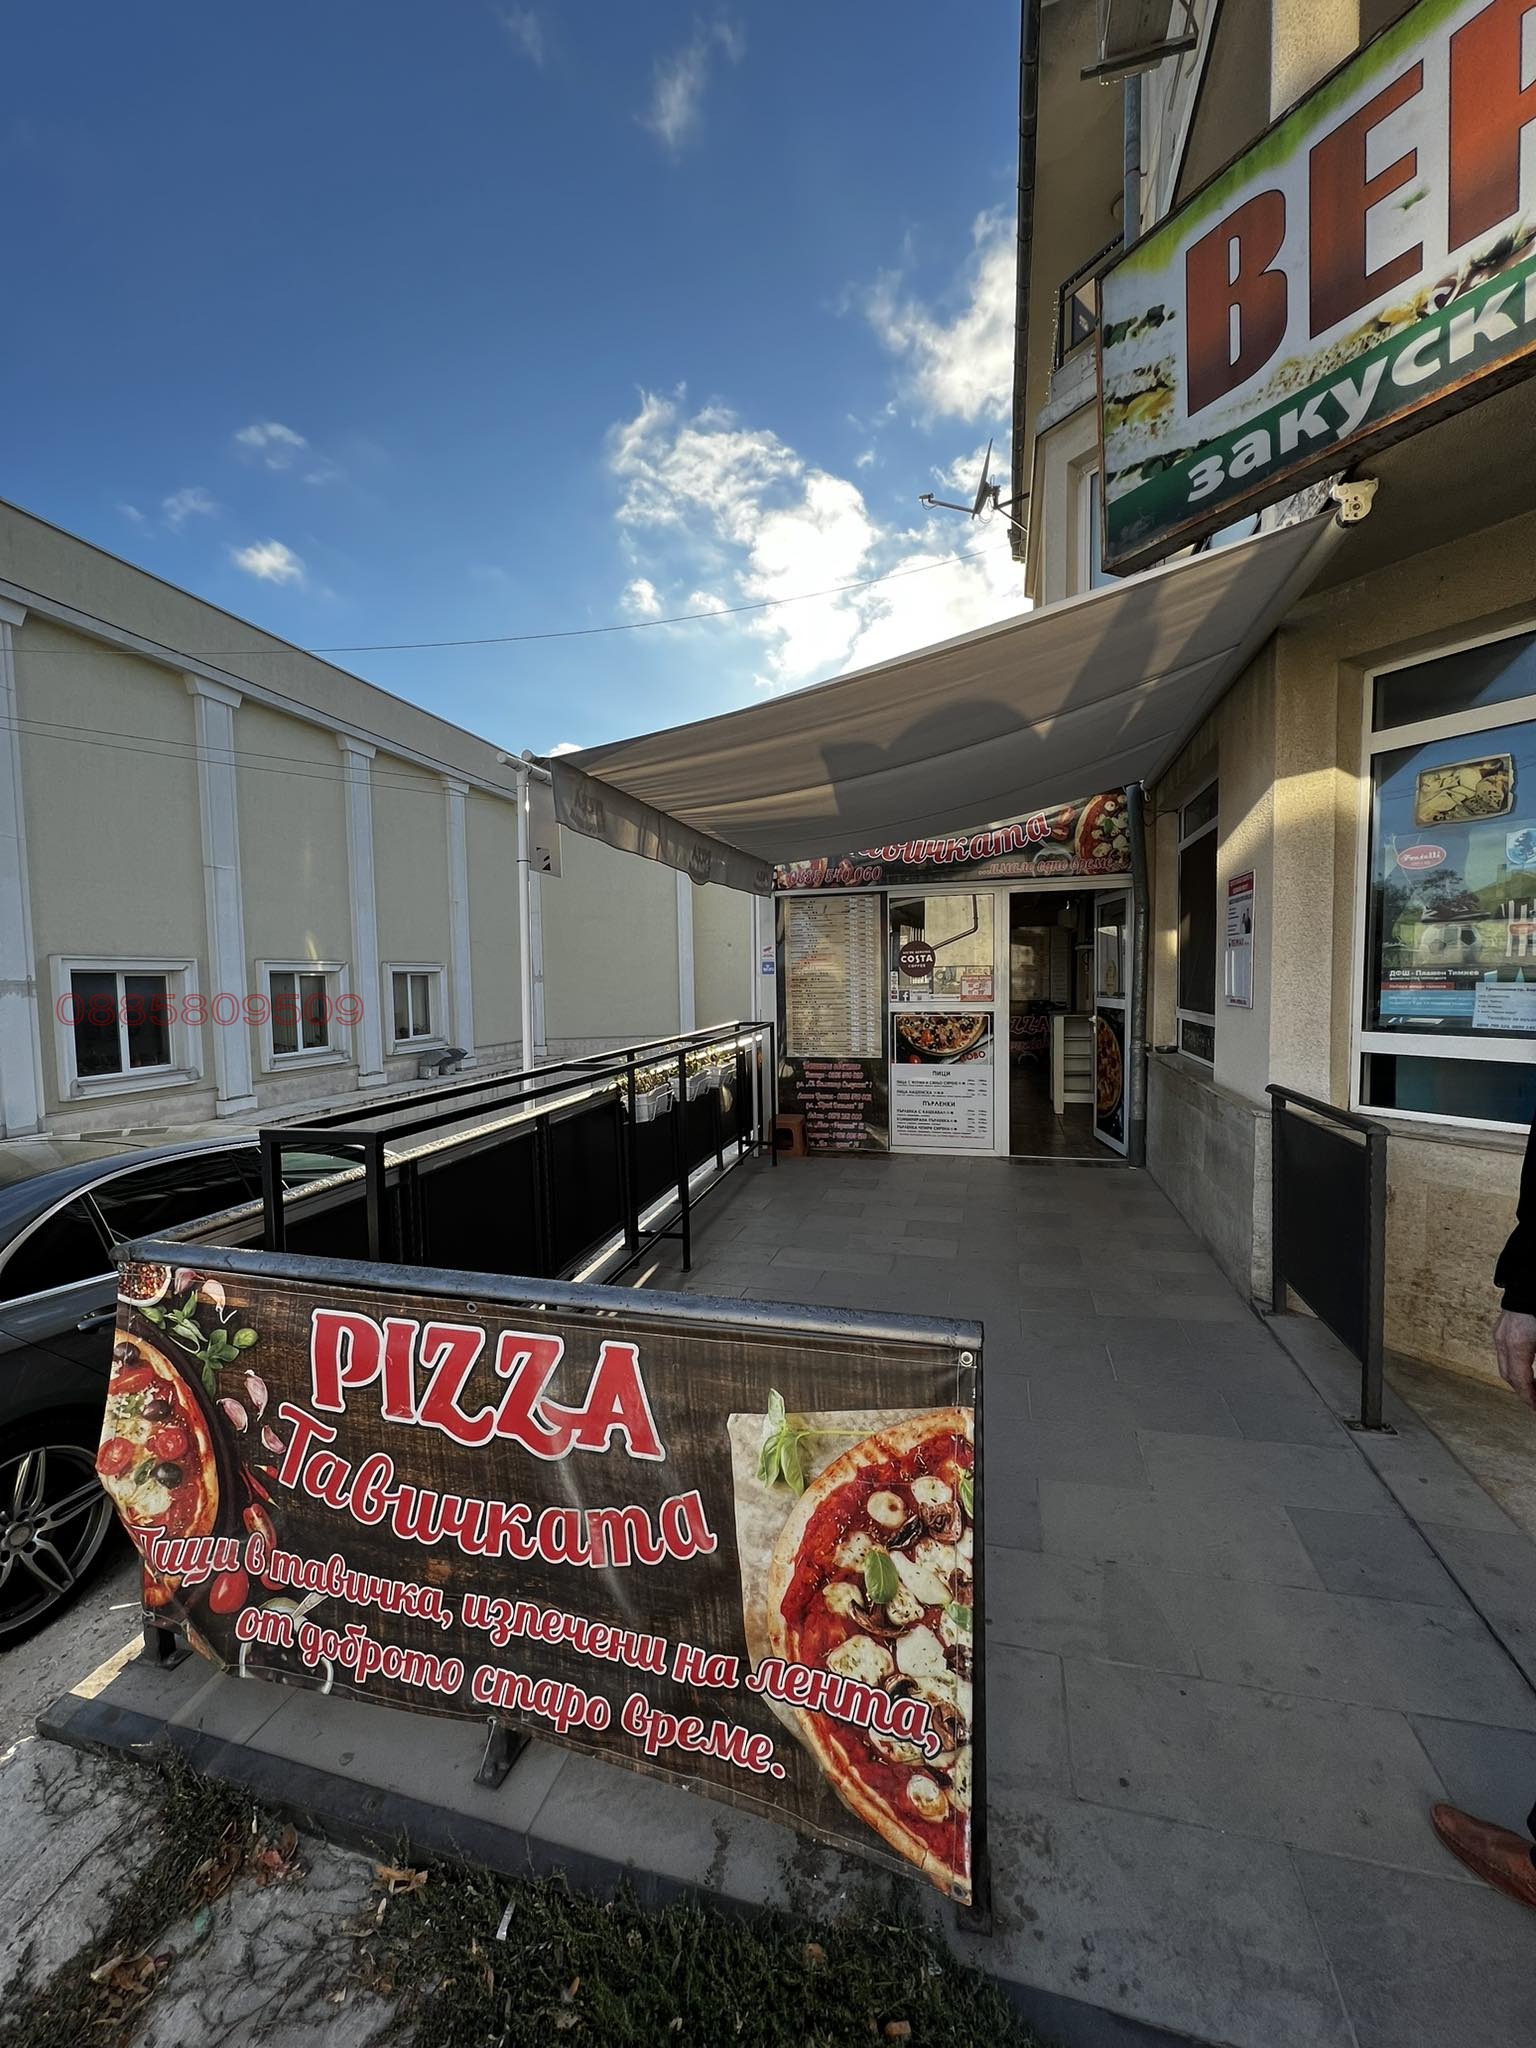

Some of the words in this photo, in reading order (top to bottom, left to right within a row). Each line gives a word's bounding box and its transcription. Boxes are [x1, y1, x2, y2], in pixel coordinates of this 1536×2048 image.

[1187, 274, 1536, 502] закуск
[900, 954, 933, 963] COSTA
[312, 1308, 666, 1462] PIZZA
[279, 1402, 718, 1569] Тавичката
[235, 1607, 293, 1648] от
[298, 1618, 465, 1694] доброто
[471, 1663, 612, 1734] старо
[621, 1692, 788, 1780] време.
[245, 1531, 266, 1575] в
[269, 1548, 453, 1629] тавичка,
[461, 1592, 667, 1674] изпечени
[672, 1642, 740, 1690] на
[746, 1656, 943, 1759] лента,
